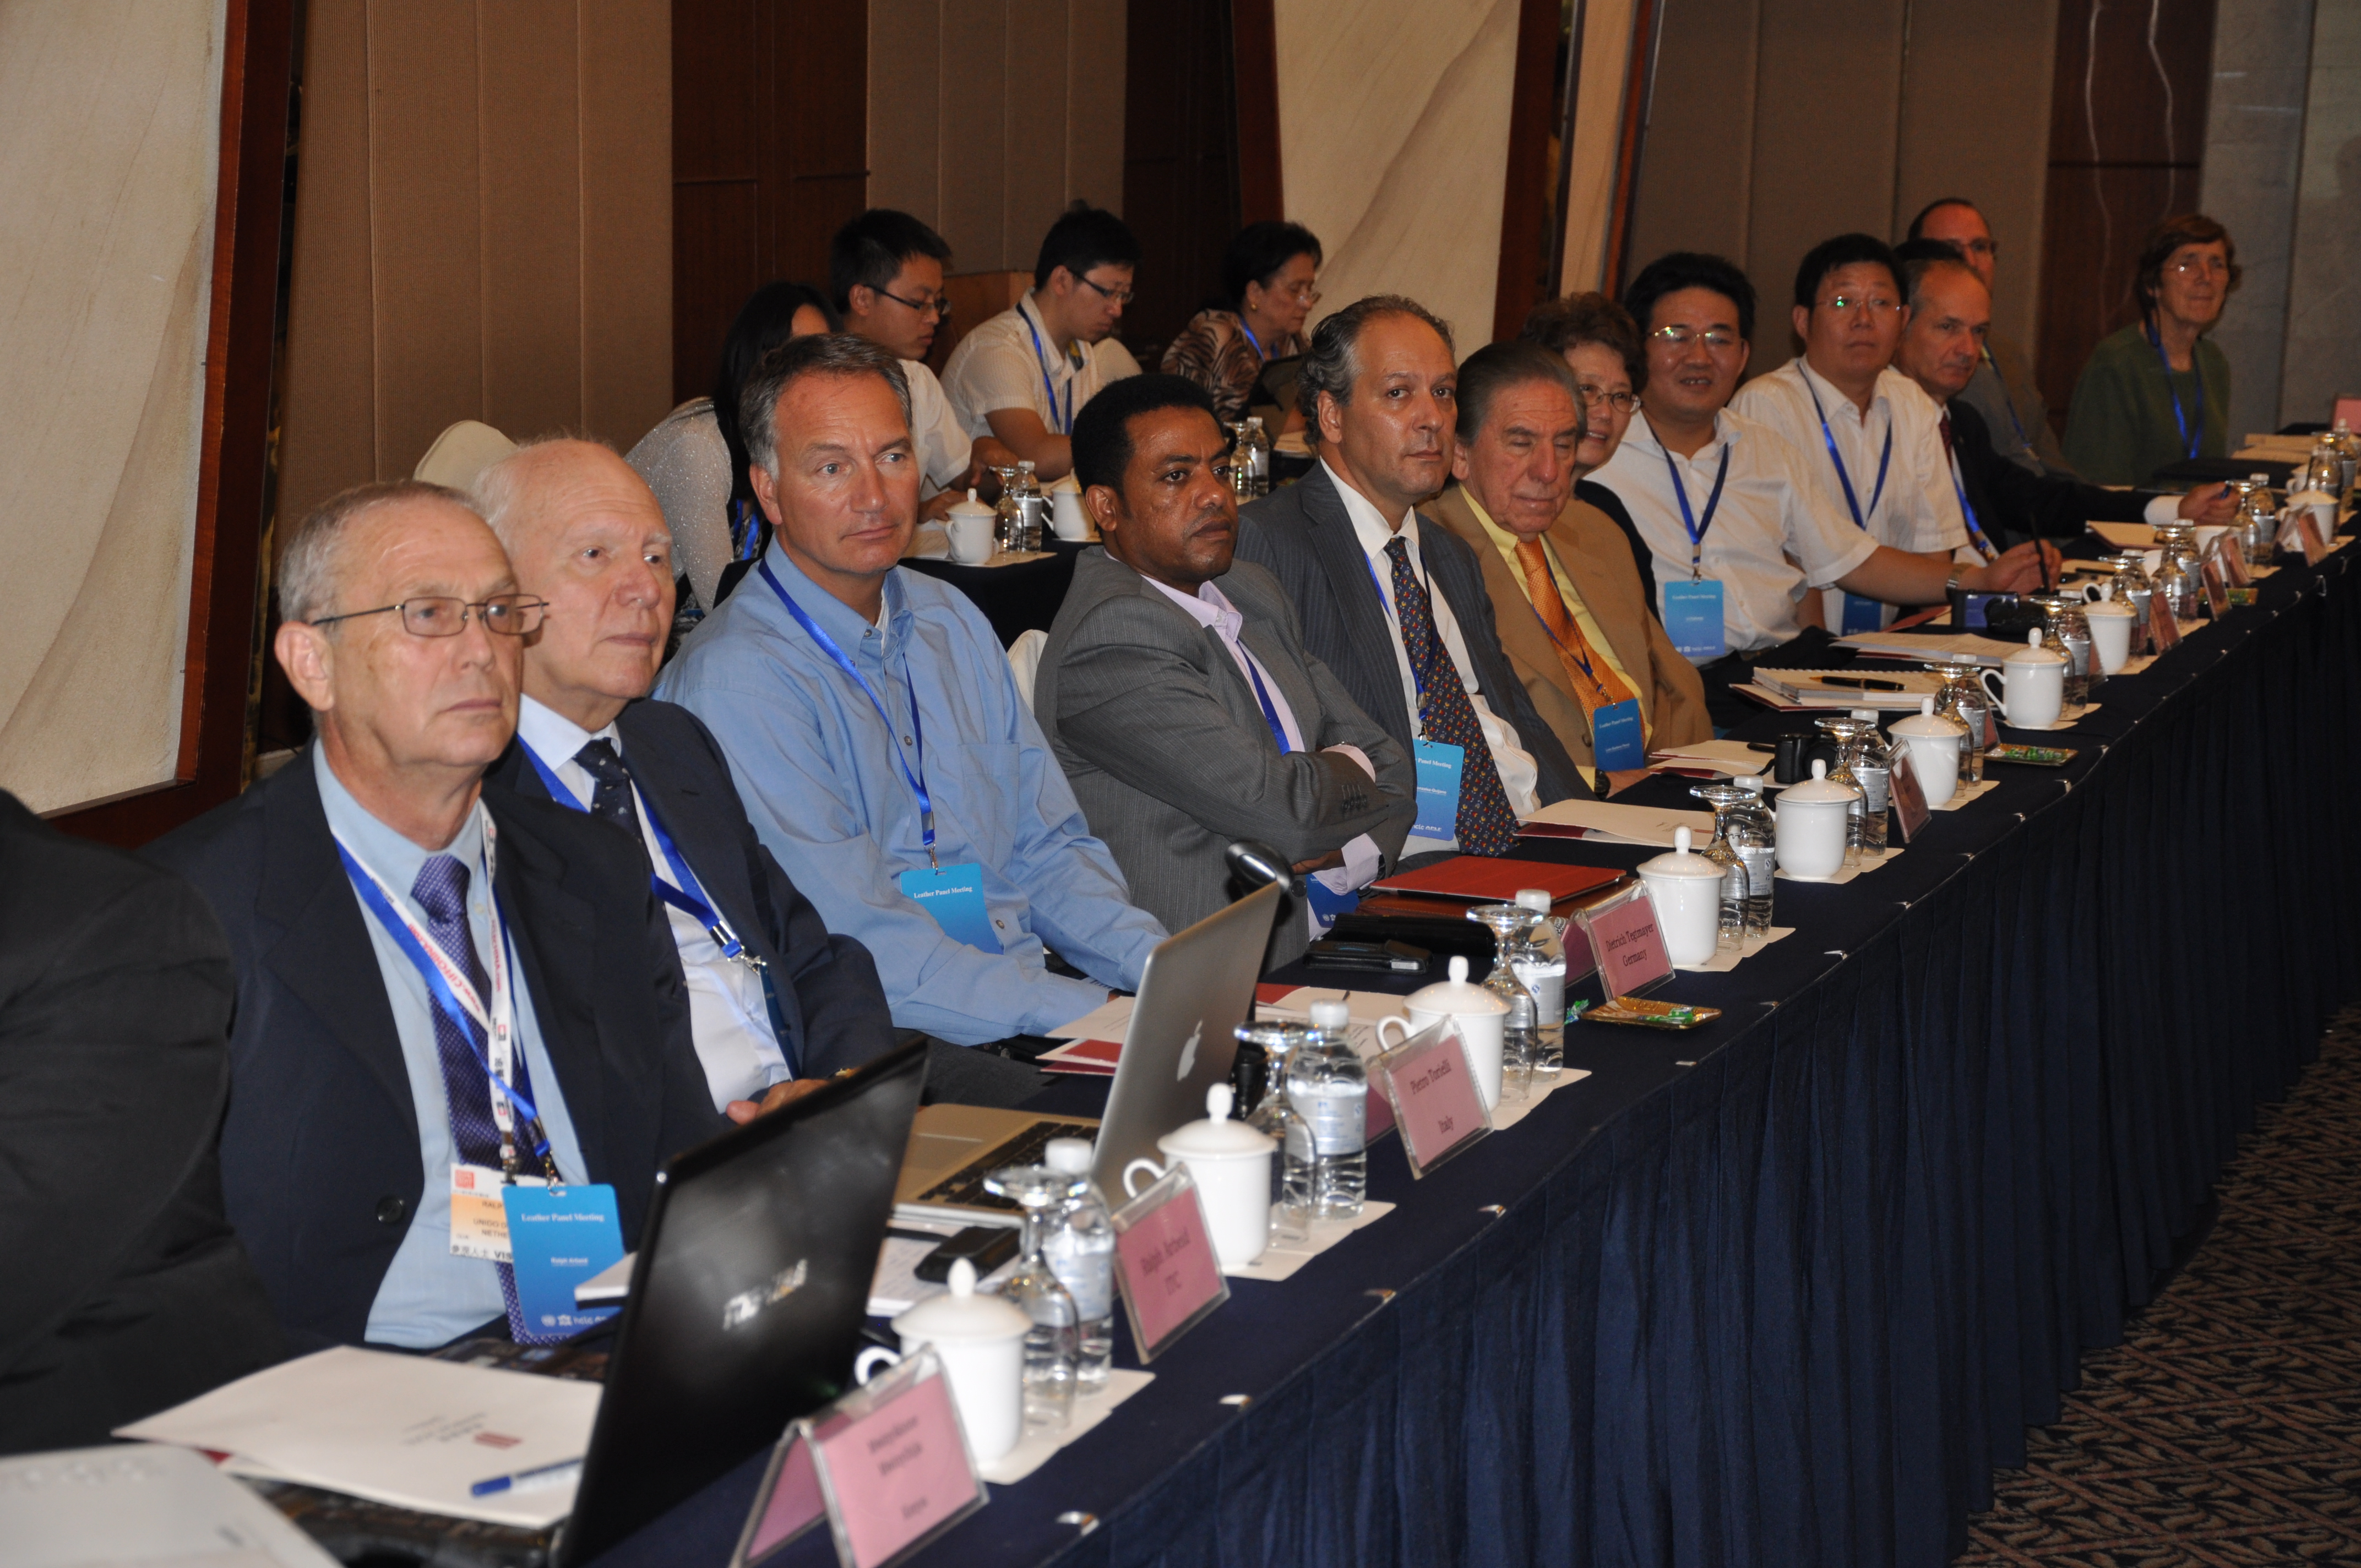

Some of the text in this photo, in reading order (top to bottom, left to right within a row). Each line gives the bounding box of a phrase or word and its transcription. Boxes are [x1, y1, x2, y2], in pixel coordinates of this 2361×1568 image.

[1432, 760, 1452, 769] Meeting
[1606, 923, 1653, 952] Dietrich Tegtmayer
[1623, 949, 1647, 967] Germany
[1438, 1115, 1454, 1135] Italy
[482, 1200, 503, 1210] RALP
[521, 1213, 605, 1223] Leather Panel Meeting
[481, 1229, 508, 1238] NETHE
[494, 1250, 512, 1261] VIS
